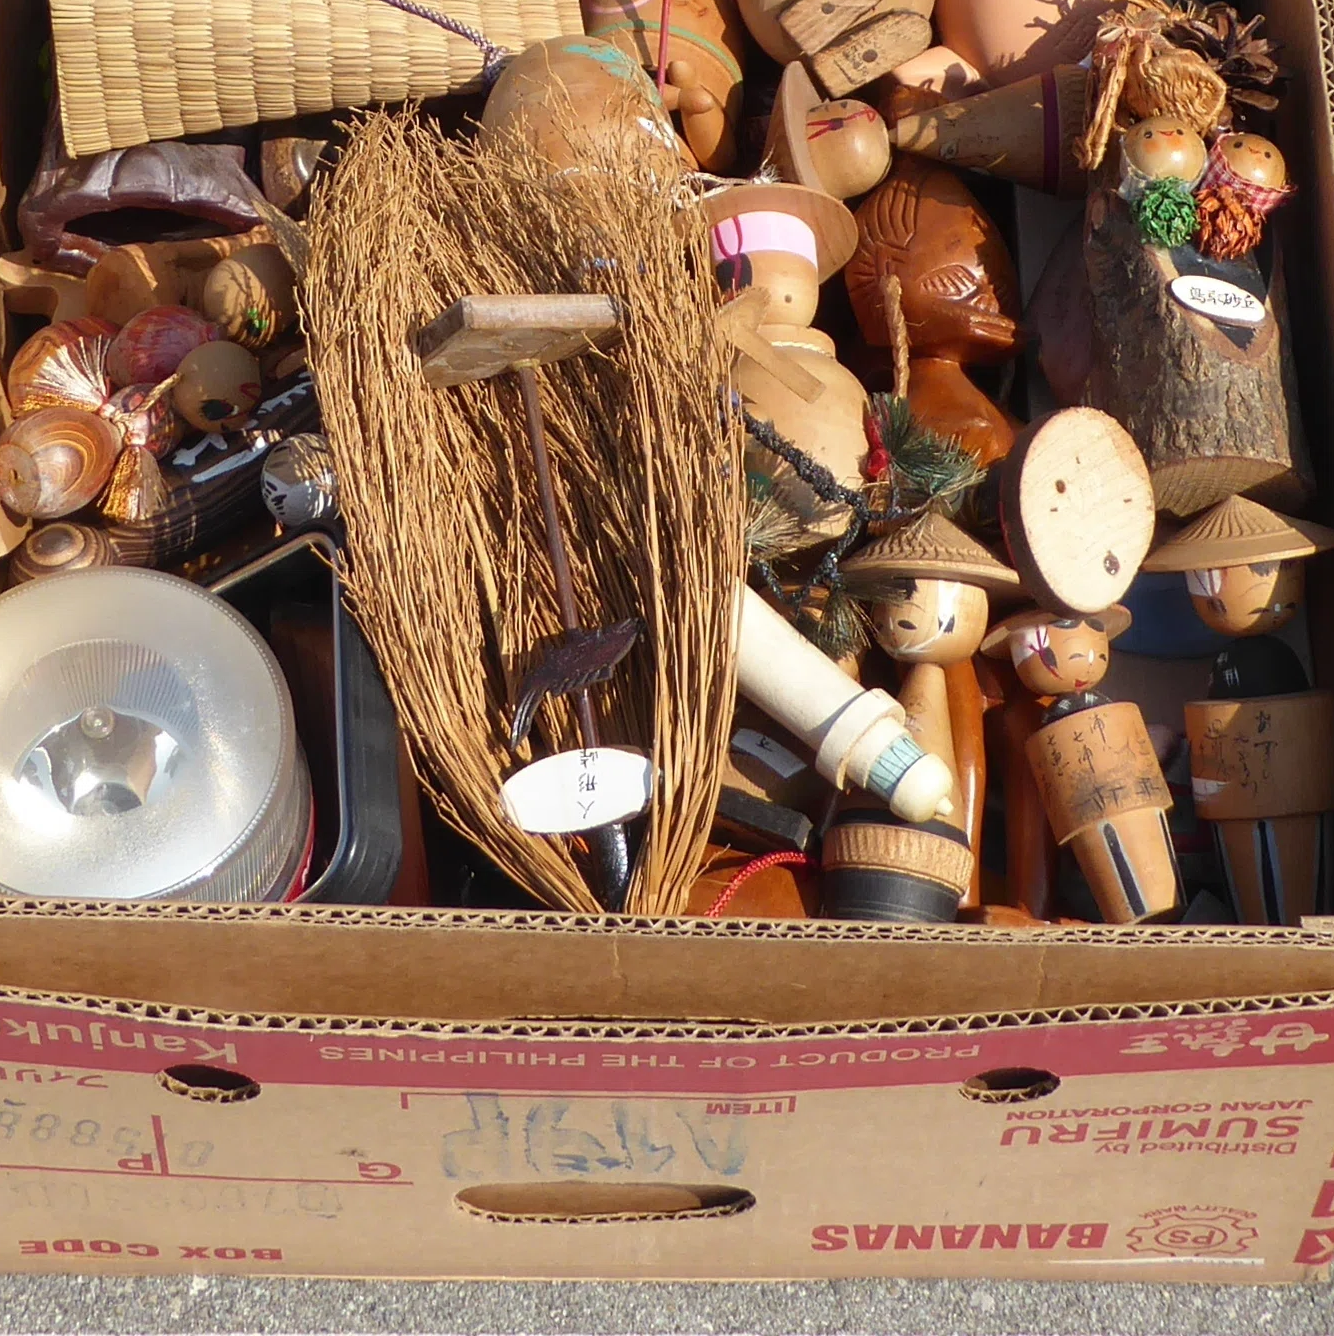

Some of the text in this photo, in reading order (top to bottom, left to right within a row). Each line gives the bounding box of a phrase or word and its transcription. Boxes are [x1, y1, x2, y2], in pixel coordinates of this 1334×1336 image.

[1117, 1017, 1331, 1059] 甘熟王
[319, 1042, 983, 1070] PRODUCT OF THE PHILIPPINES
[704, 1101, 786, 1117] ITEM
[1005, 1098, 1315, 1122] JAPAN CORPORATION
[998, 1114, 1306, 1147] SUMIFRU
[1092, 1140, 1299, 1157] Distributed by
[117, 1151, 156, 1172] P
[356, 1160, 403, 1181] G
[1137, 1203, 1259, 1221] QUALITY MARK
[811, 1222, 1110, 1252] BANANAS
[1166, 1227, 1217, 1248] PS
[16, 1238, 284, 1262] BOX CODE
